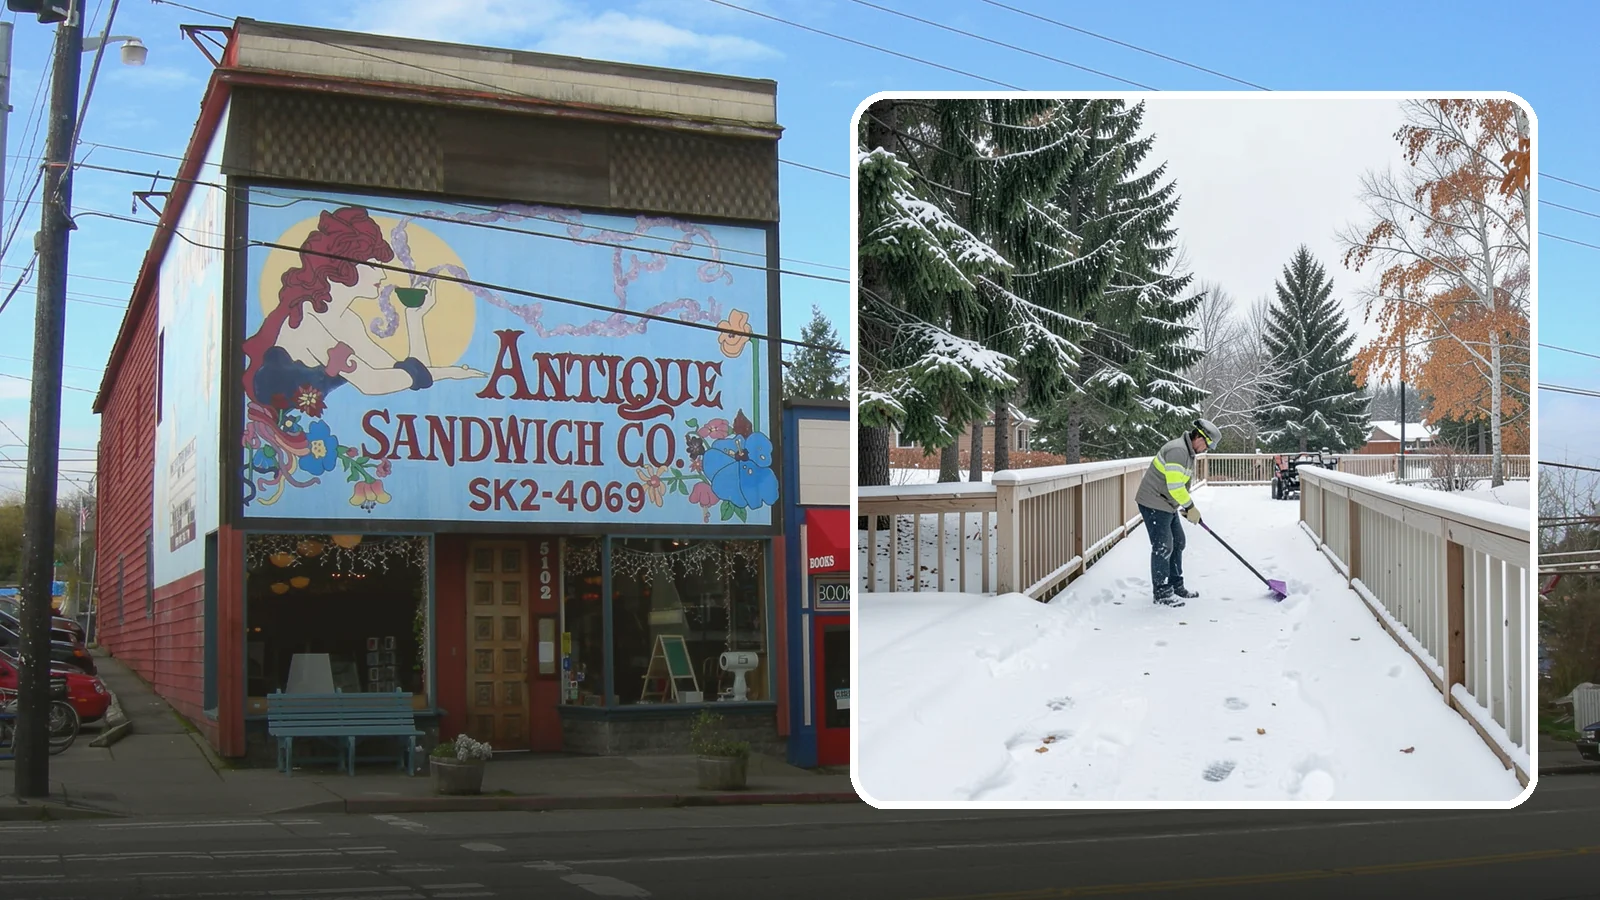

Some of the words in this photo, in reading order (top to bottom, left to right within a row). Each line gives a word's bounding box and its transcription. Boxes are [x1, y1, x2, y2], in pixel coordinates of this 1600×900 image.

[476, 329, 724, 420] ANTIQUE
[361, 408, 603, 468] SANDWICH
[616, 420, 685, 469] CO.
[468, 476, 647, 514] SK2-4069
[539, 541, 552, 600] 5102
[809, 555, 835, 569] BOOKS
